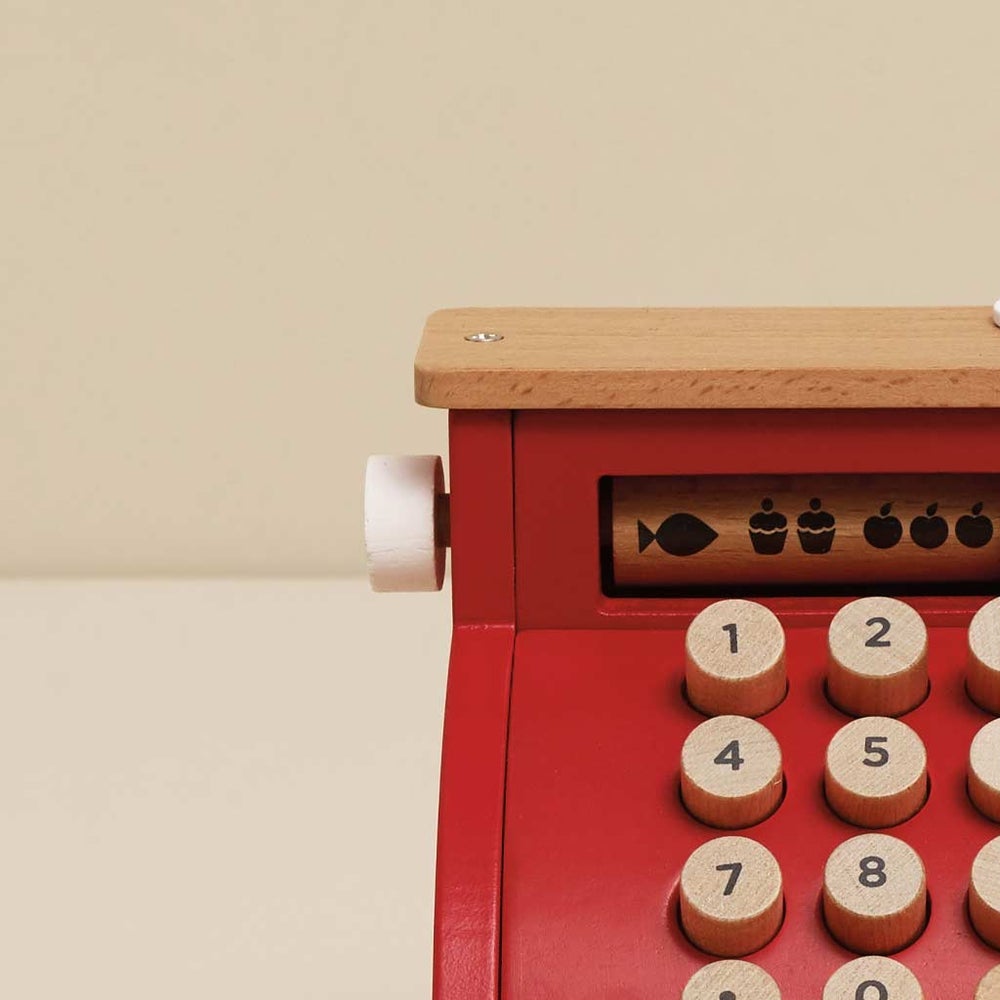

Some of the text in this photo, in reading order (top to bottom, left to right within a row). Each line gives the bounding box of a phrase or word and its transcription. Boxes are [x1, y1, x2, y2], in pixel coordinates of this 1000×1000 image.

[722, 624, 738, 653] 1
[865, 617, 891, 647] 2
[714, 740, 744, 771] 4
[862, 737, 889, 768] 5
[716, 863, 743, 896] 7
[859, 856, 887, 888] 8
